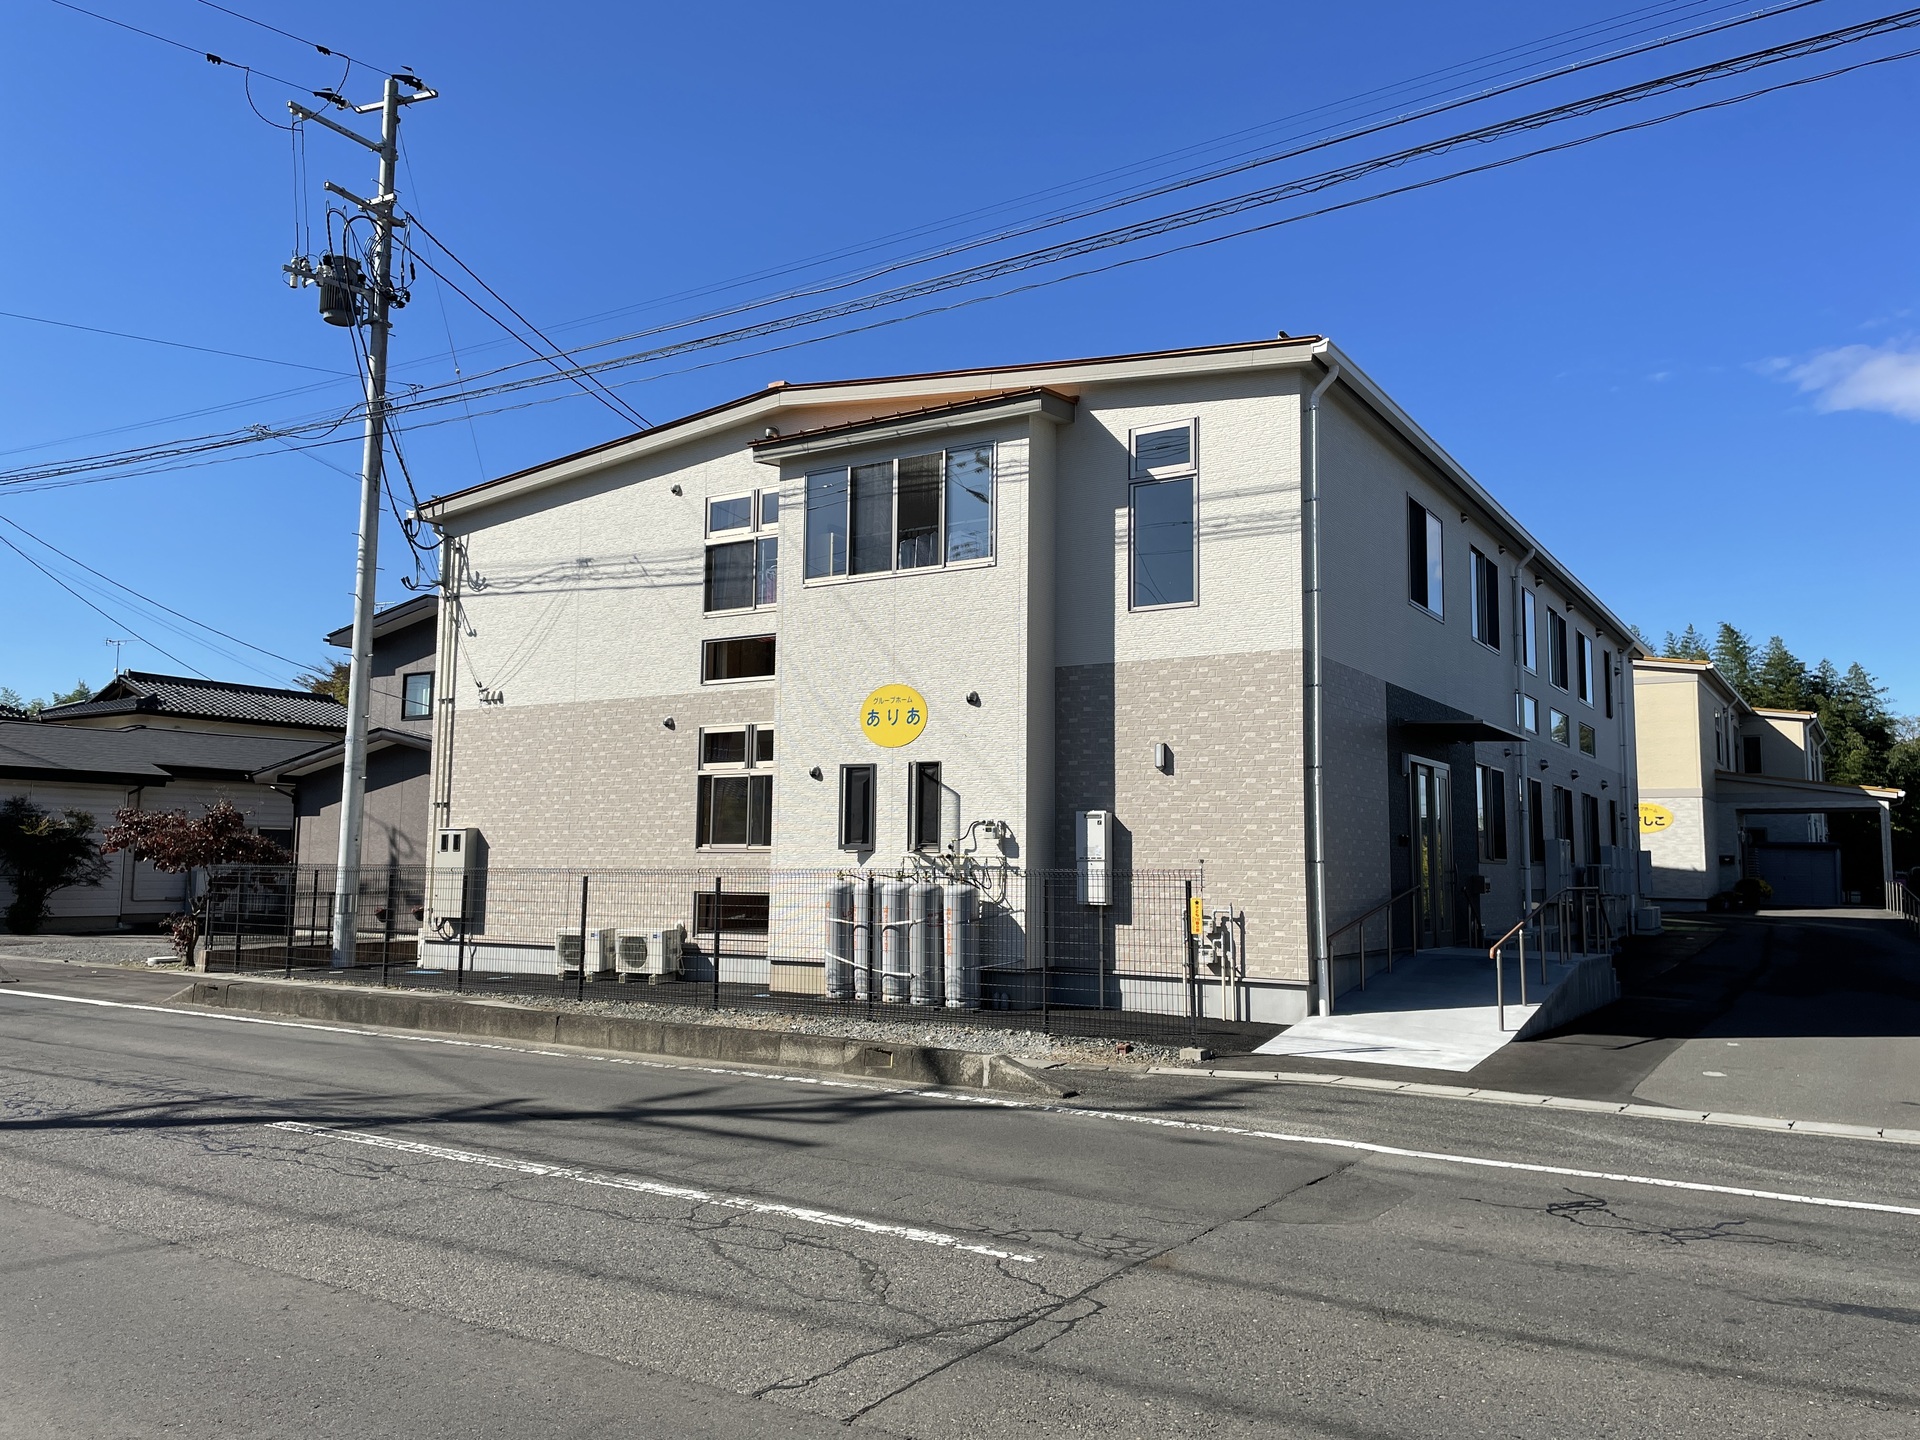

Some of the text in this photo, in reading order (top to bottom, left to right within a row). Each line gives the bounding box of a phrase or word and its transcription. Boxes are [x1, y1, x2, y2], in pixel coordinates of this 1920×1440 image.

[873, 696, 913, 705] グループホーム
[866, 707, 921, 727] ありあ
[1639, 816, 1665, 826] しこ
